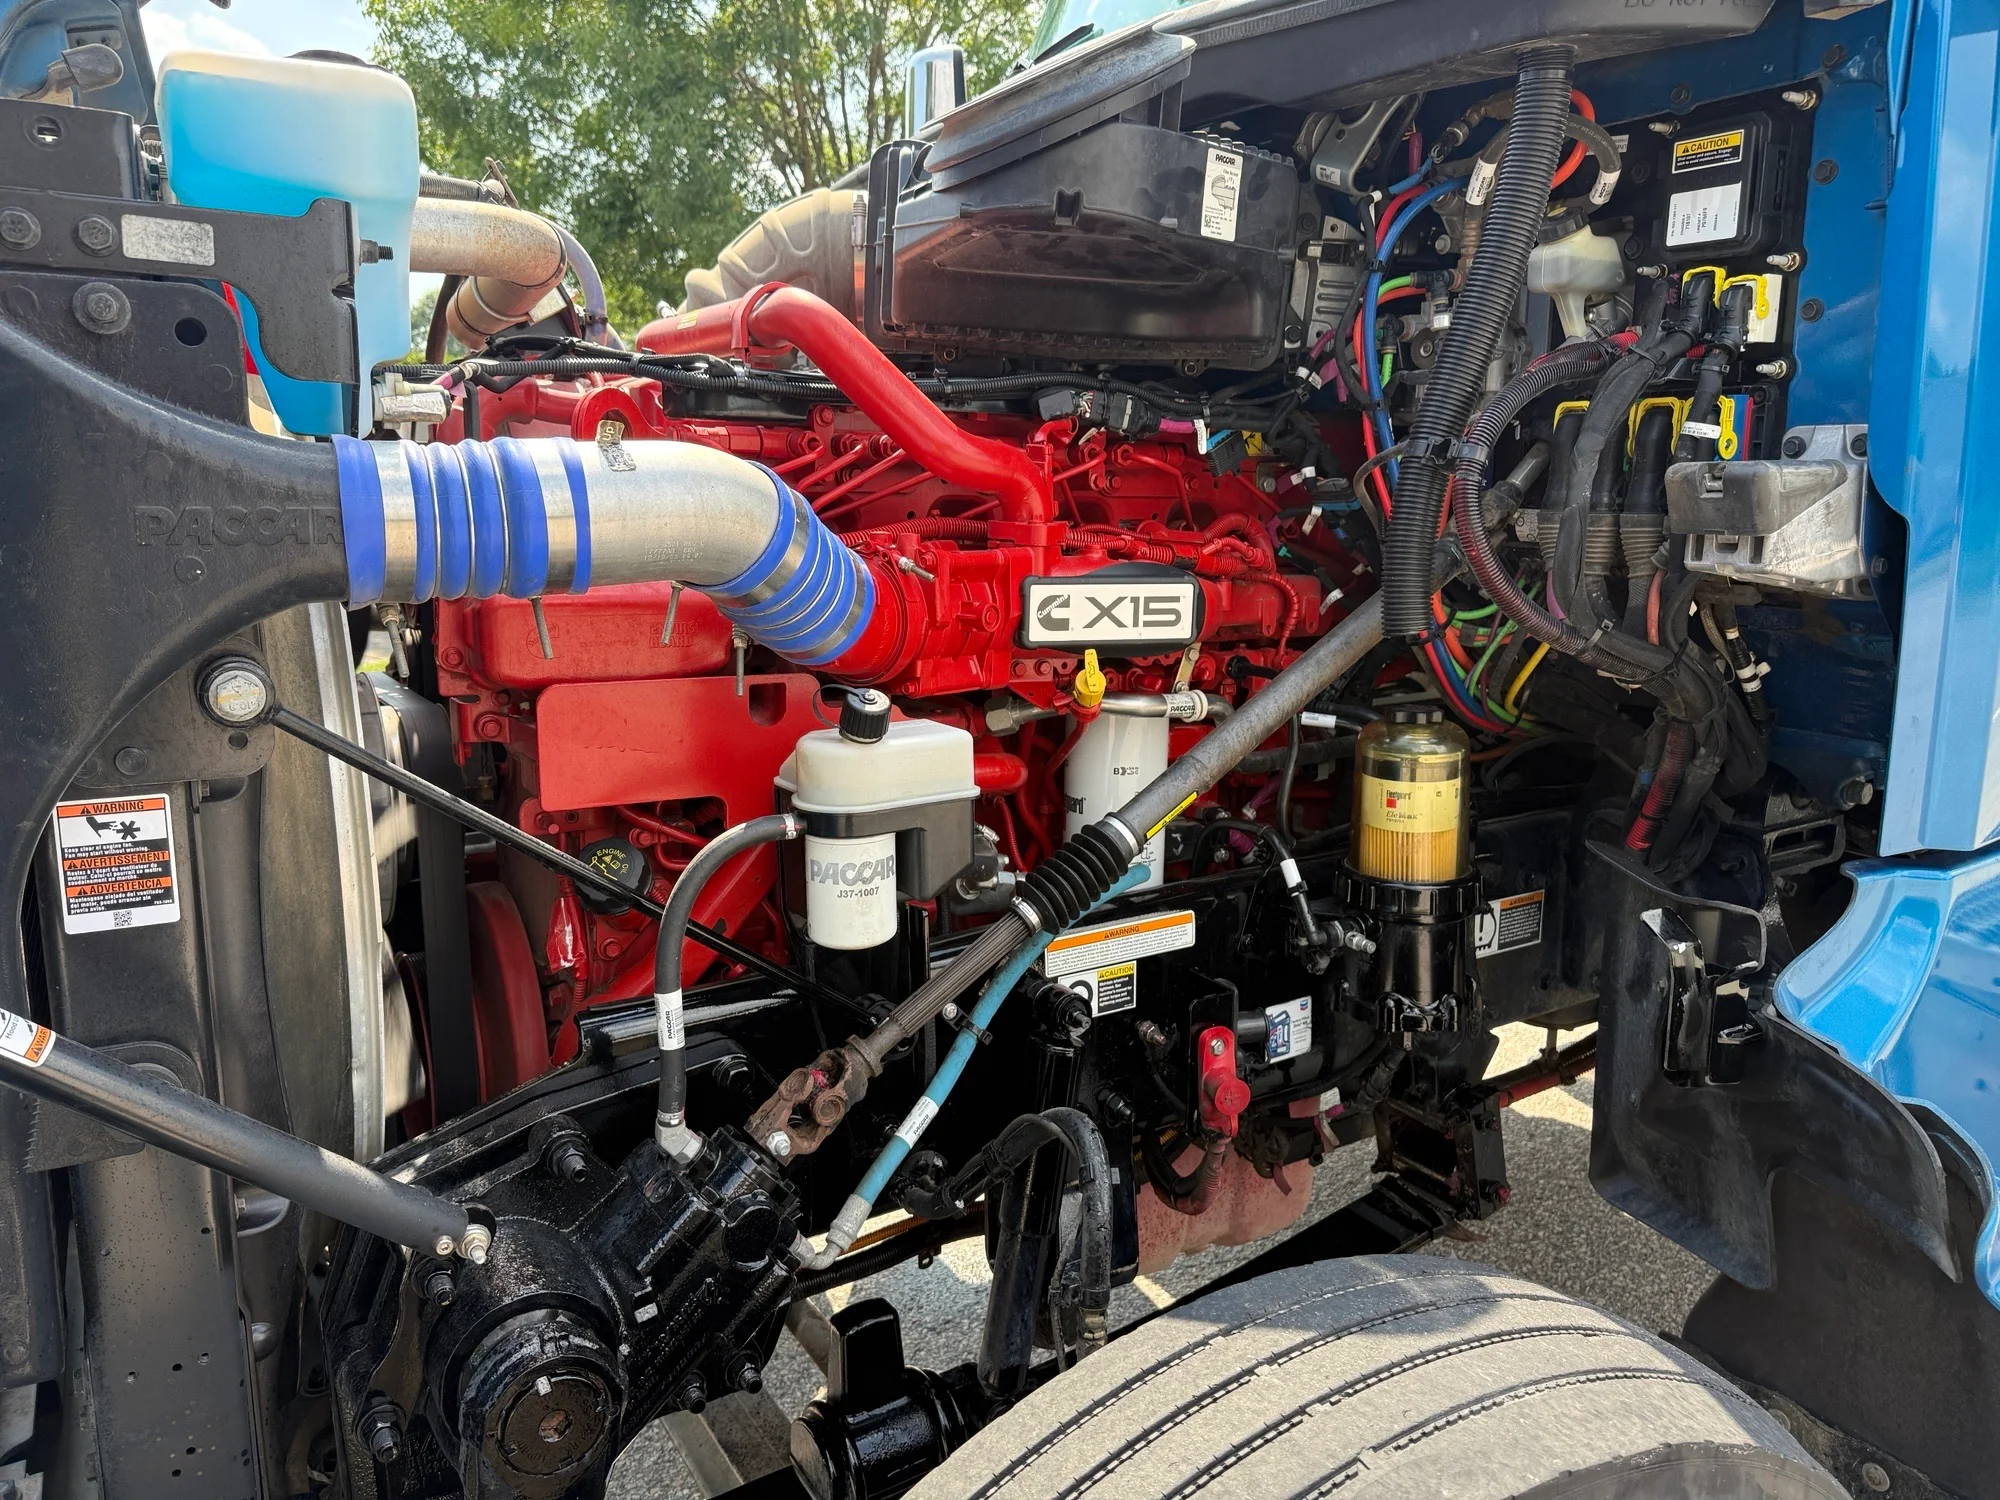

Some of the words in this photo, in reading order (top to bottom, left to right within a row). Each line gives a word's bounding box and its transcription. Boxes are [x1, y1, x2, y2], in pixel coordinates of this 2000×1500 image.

[1690, 138, 1729, 152] CAUTION
[1216, 154, 1236, 166] PACCAR
[1477, 177, 1486, 198] PACCAR
[602, 426, 615, 441] Up
[135, 506, 344, 546] PACCAR
[1082, 596, 1182, 629] X15
[1386, 790, 1412, 800] Fleetguard
[93, 801, 144, 814] WARNING
[79, 851, 166, 868] AVERTISSEMENT
[596, 848, 626, 860] ENGINE
[620, 863, 629, 875] OIL
[810, 854, 895, 887] PACCAR
[89, 878, 162, 894] ADVERTENCIA
[836, 886, 880, 899] J37-1007
[1108, 925, 1140, 938] WARNING
[1104, 966, 1134, 977] CAUTION
[5, 1021, 17, 1039] Hood
